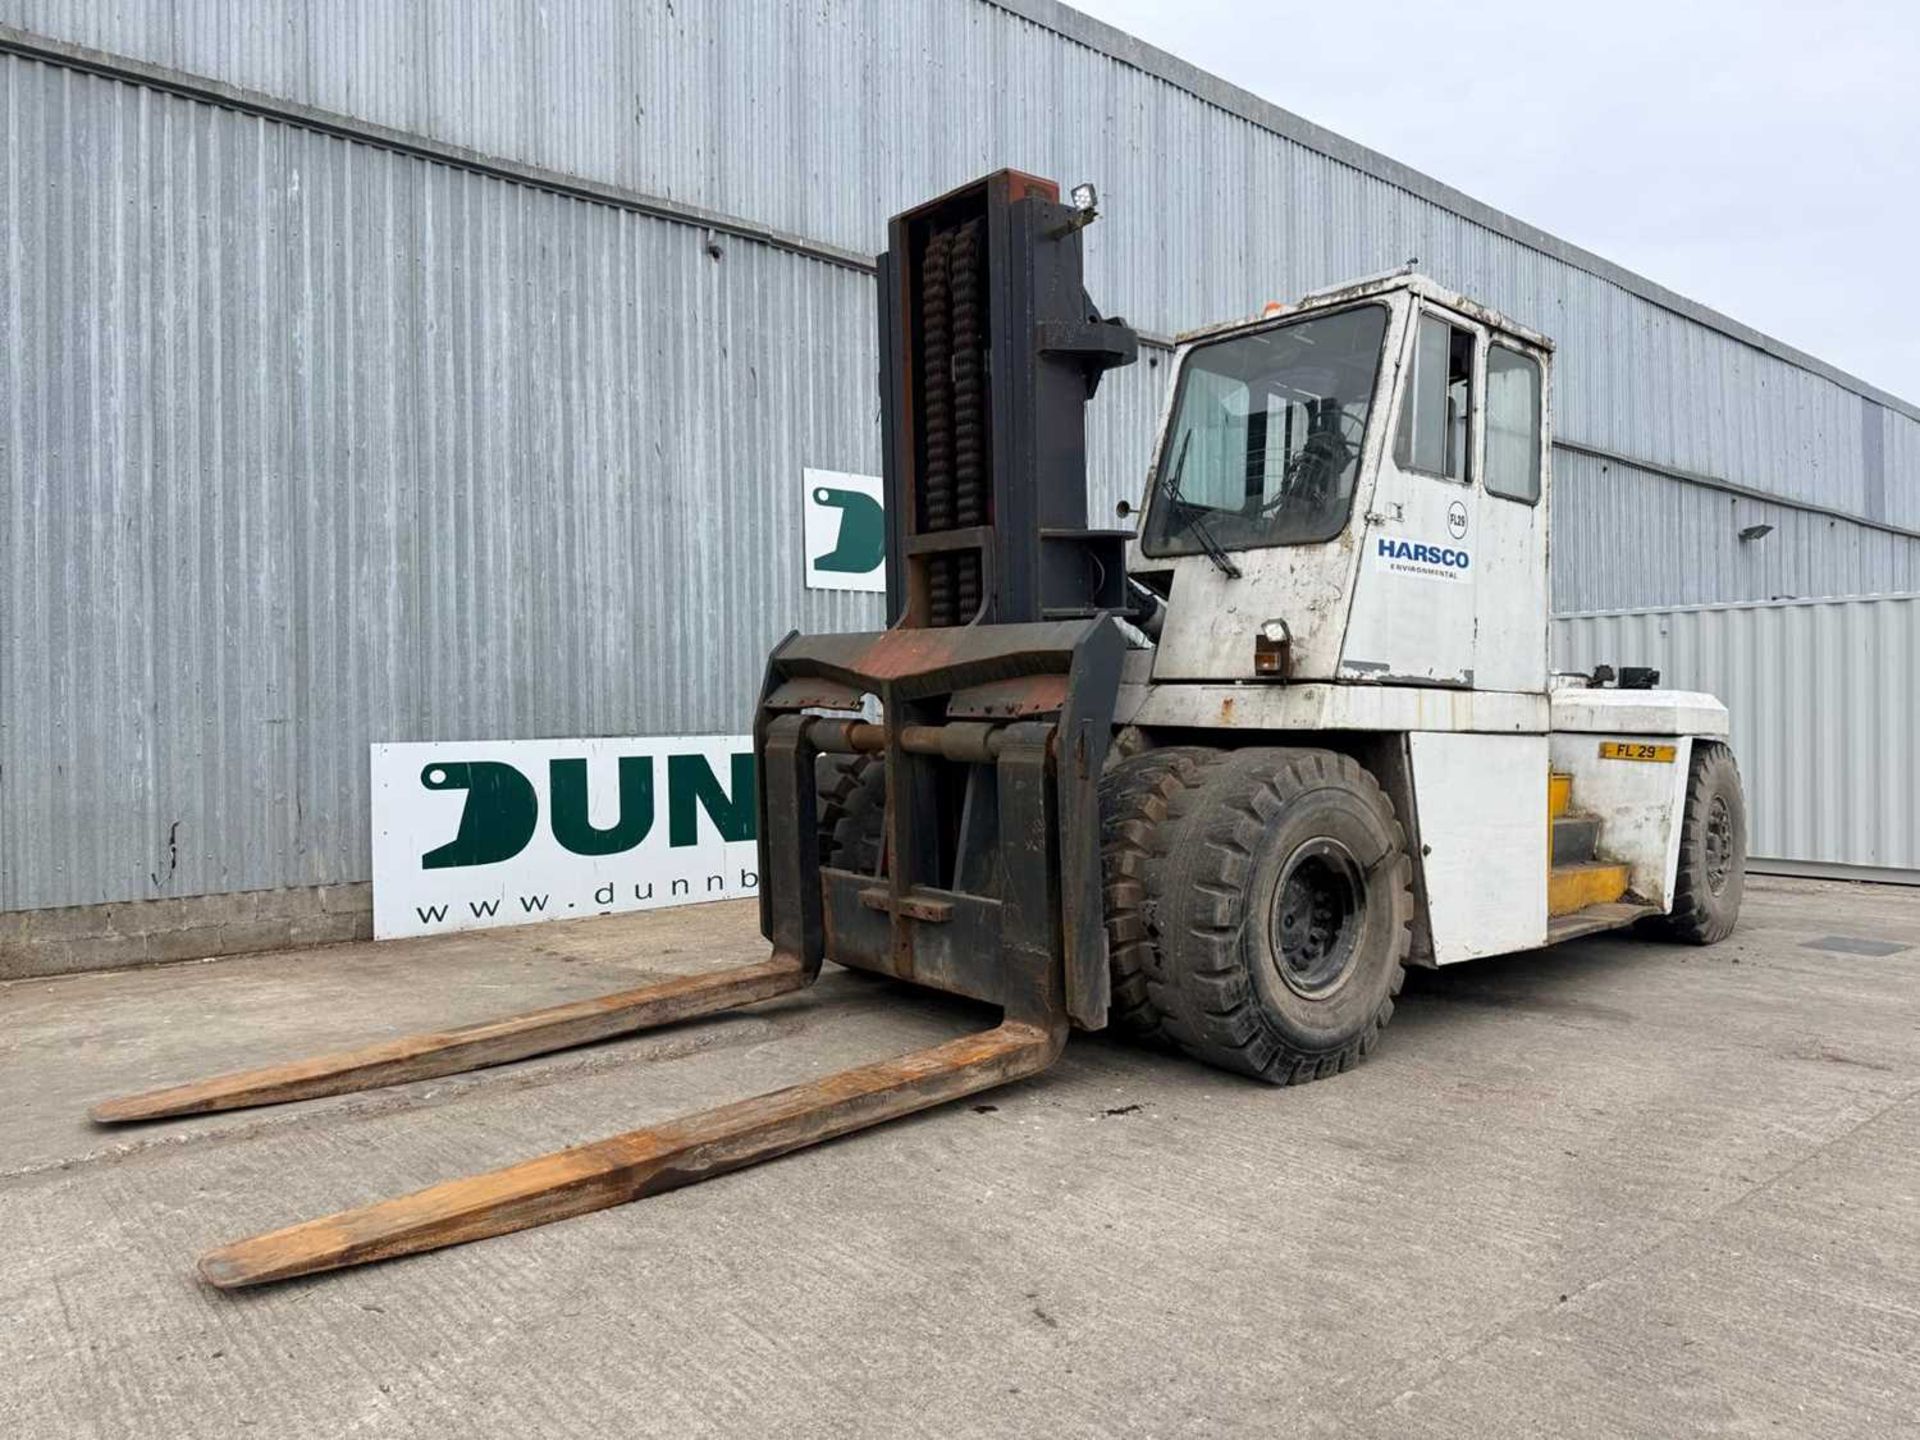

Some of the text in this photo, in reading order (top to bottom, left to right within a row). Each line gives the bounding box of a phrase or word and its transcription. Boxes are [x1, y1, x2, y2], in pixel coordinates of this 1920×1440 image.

[1378, 539, 1469, 569] HARSCO
[1390, 563, 1458, 580] ENVIRONMENTAL
[1617, 744, 1656, 758] FL 29
